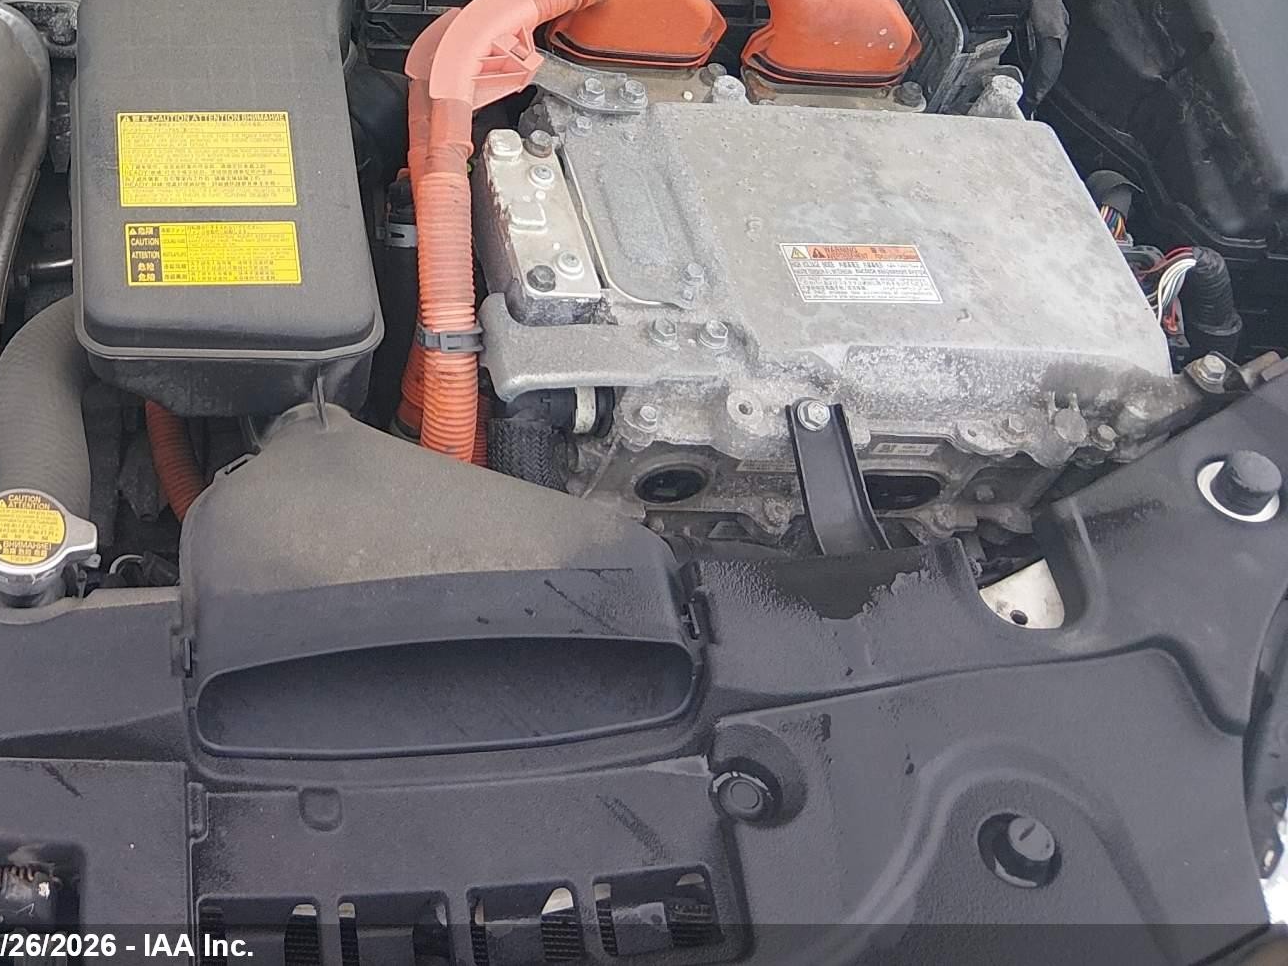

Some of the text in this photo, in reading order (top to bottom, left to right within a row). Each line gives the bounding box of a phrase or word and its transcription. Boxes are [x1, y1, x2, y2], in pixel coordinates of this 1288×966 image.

[151, 114, 190, 122] CAUTION
[192, 114, 239, 122] ATTENTION
[241, 114, 285, 122] ВНИМАНИЕ
[131, 237, 159, 246] CAUTION
[132, 251, 160, 259] ATTENTION
[8, 494, 41, 503] CAUTION
[7, 501, 50, 510] ATTENTION
